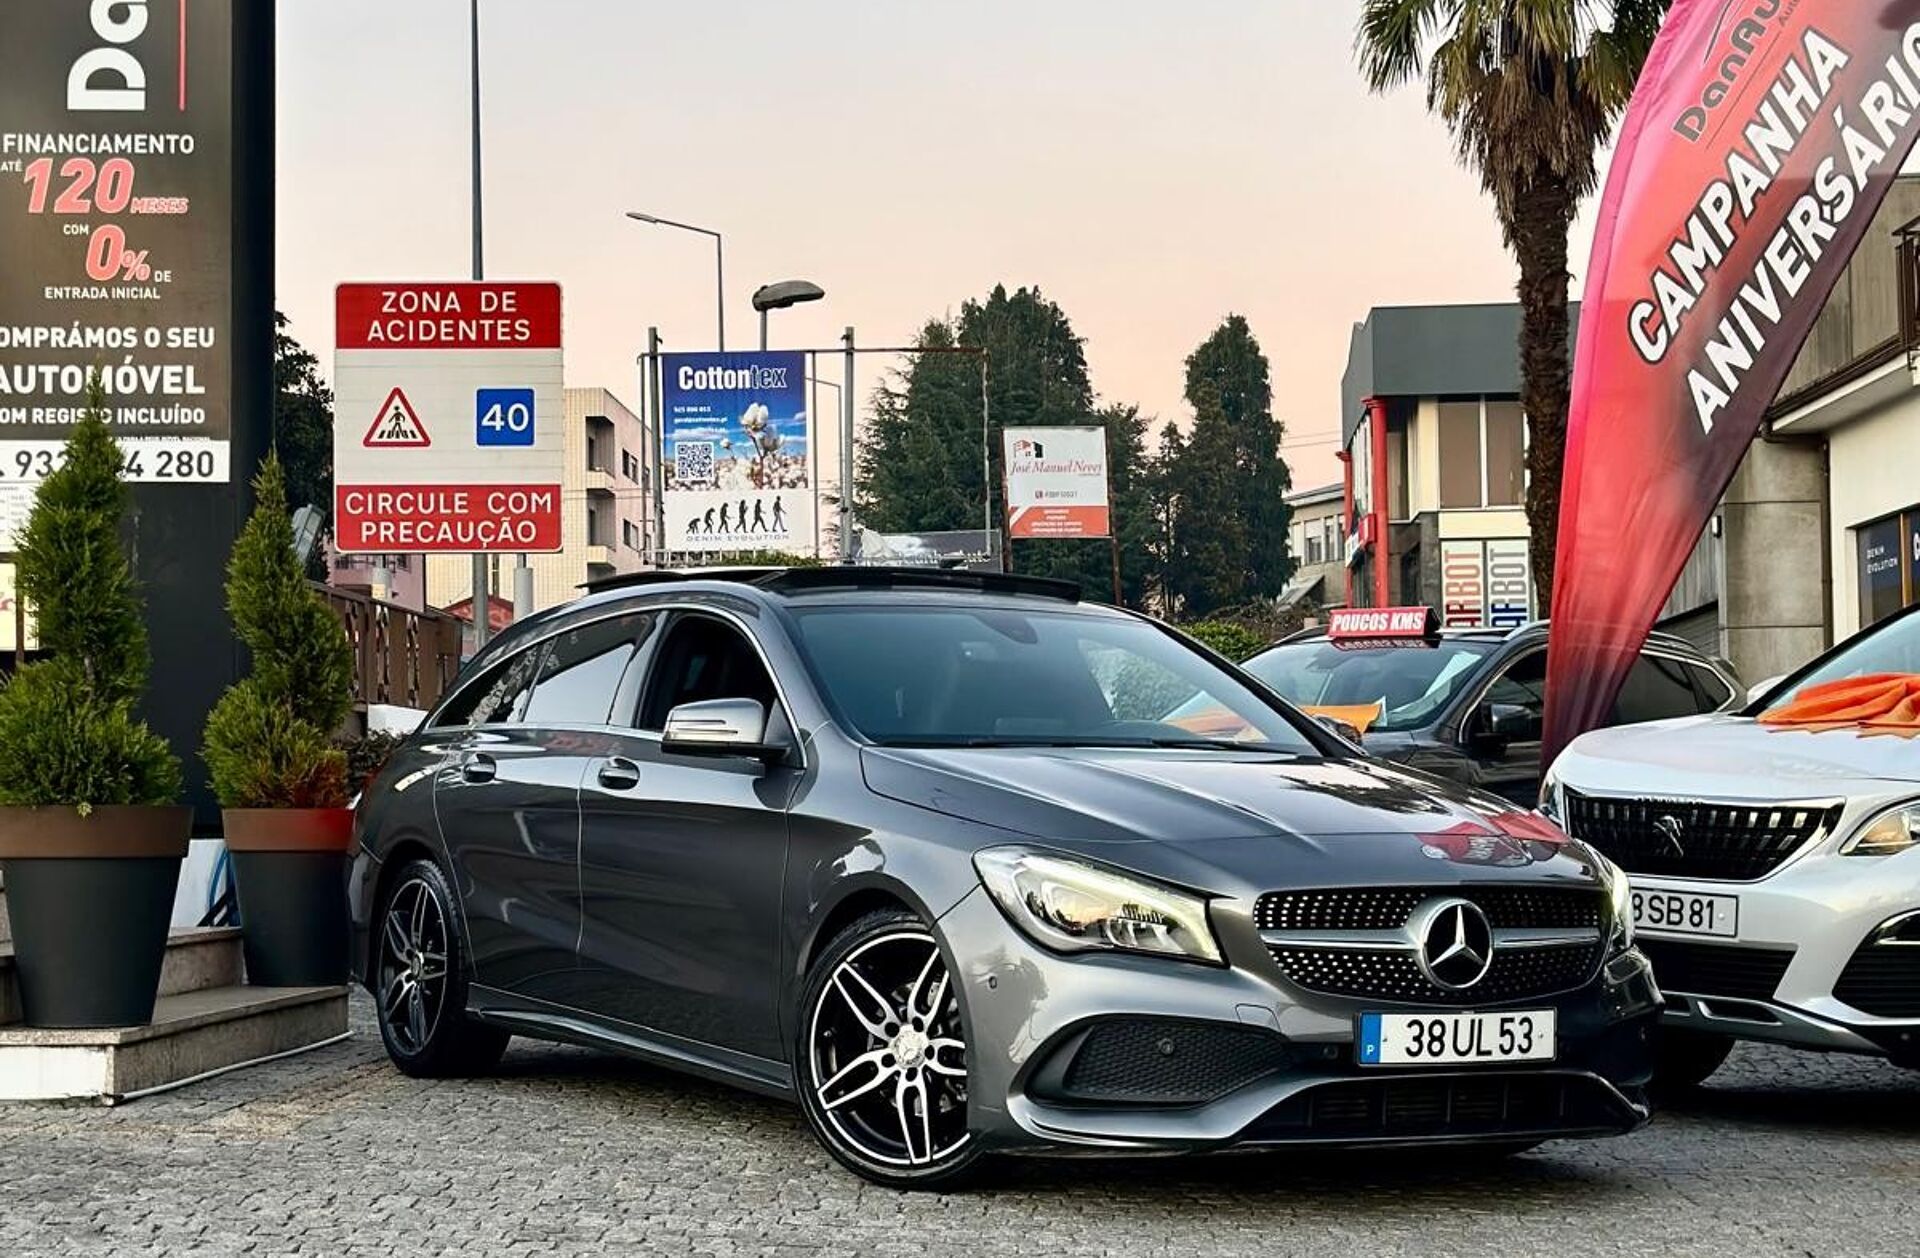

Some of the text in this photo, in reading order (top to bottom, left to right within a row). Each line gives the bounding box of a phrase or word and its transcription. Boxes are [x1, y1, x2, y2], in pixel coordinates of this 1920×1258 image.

[3, 133, 195, 155] FINANCIAMENTO
[1, 157, 189, 214] ATÉ 120 MESES
[1631, 28, 1850, 363] CAMPANHA
[63, 224, 172, 283] COM 0% DE
[44, 286, 161, 299] ENTRADA INICIAL
[381, 290, 517, 314] ZONA DE
[144, 327, 160, 349] O
[166, 327, 215, 349] SEU
[367, 319, 531, 342] ACIDENTES
[678, 364, 788, 390] Cottontex
[32, 407, 112, 424] REGISO
[117, 403, 206, 424] INCLUÍDO
[481, 403, 529, 432] 40
[156, 450, 214, 478] 280
[1032, 459, 1073, 474] Manuel
[345, 492, 552, 515] CIRCULE COM
[360, 516, 537, 548] PRECAUÇÃO
[1331, 611, 1424, 632] POUCOS KMS
[1366, 1045, 1374, 1056] P
